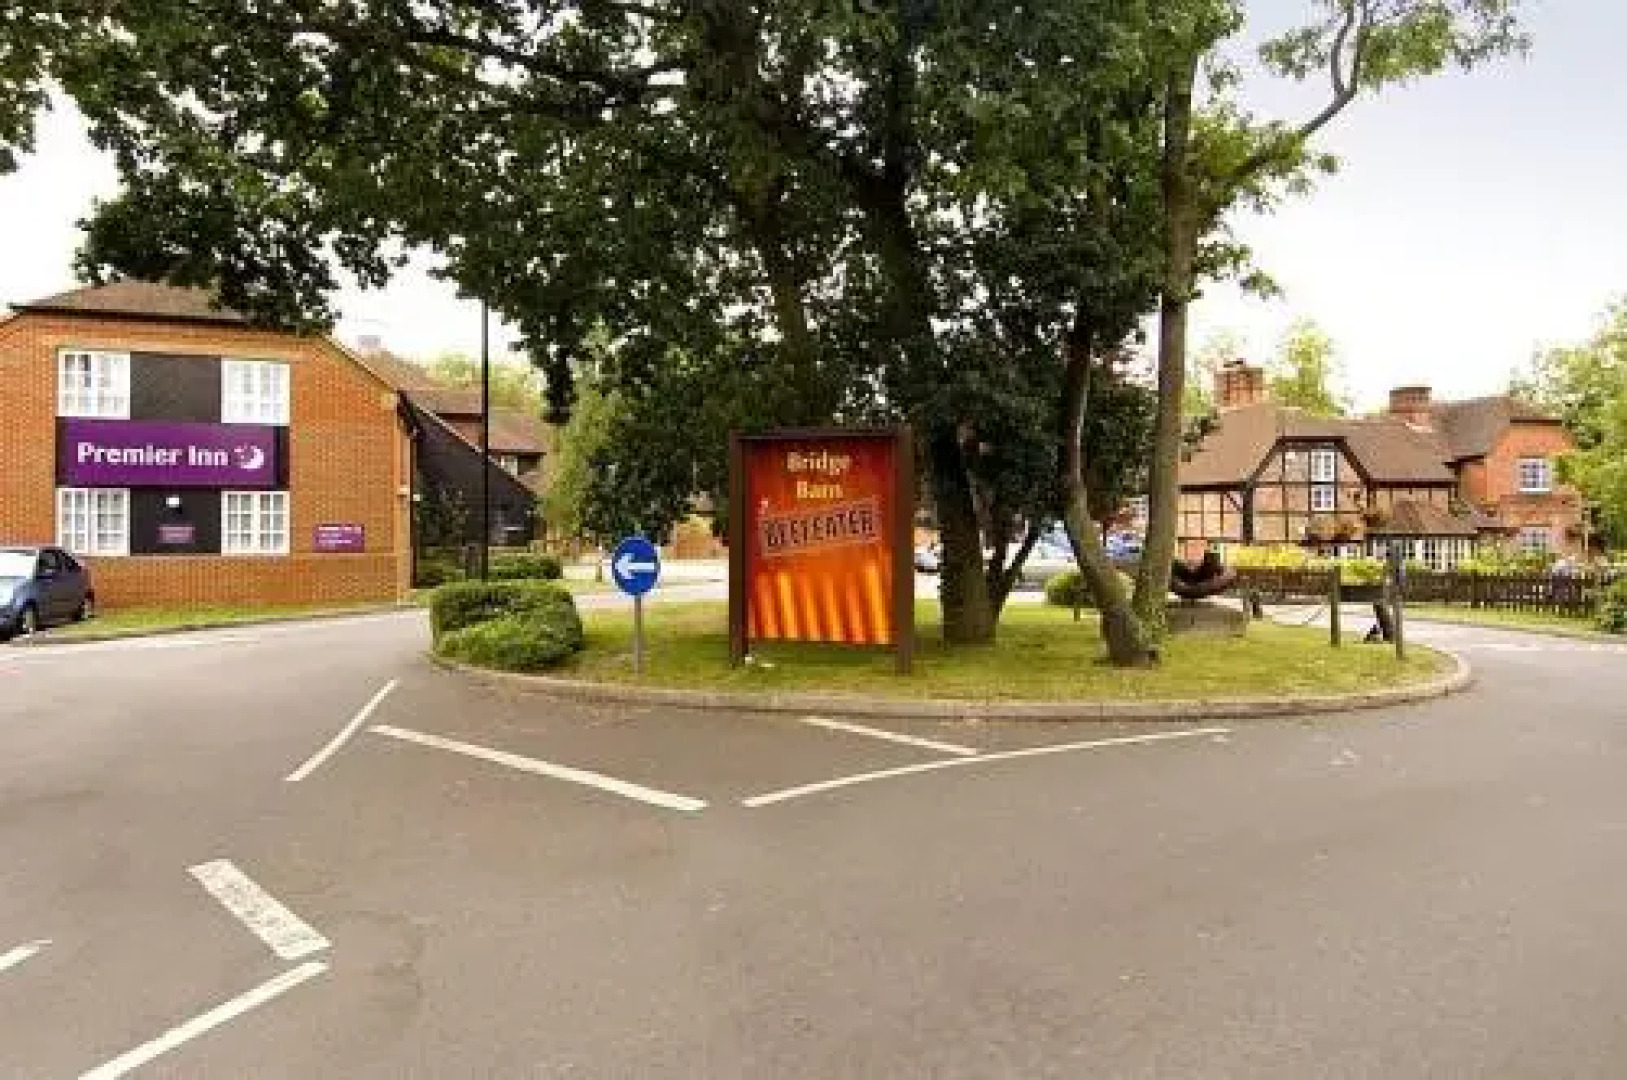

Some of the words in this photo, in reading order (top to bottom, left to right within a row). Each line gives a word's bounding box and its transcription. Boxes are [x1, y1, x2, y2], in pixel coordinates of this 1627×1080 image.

[77, 442, 182, 466] Premier
[188, 445, 229, 466] Inn
[786, 449, 851, 476] Bridge
[796, 480, 844, 499] Barn
[763, 508, 877, 548] BEEFEATER
